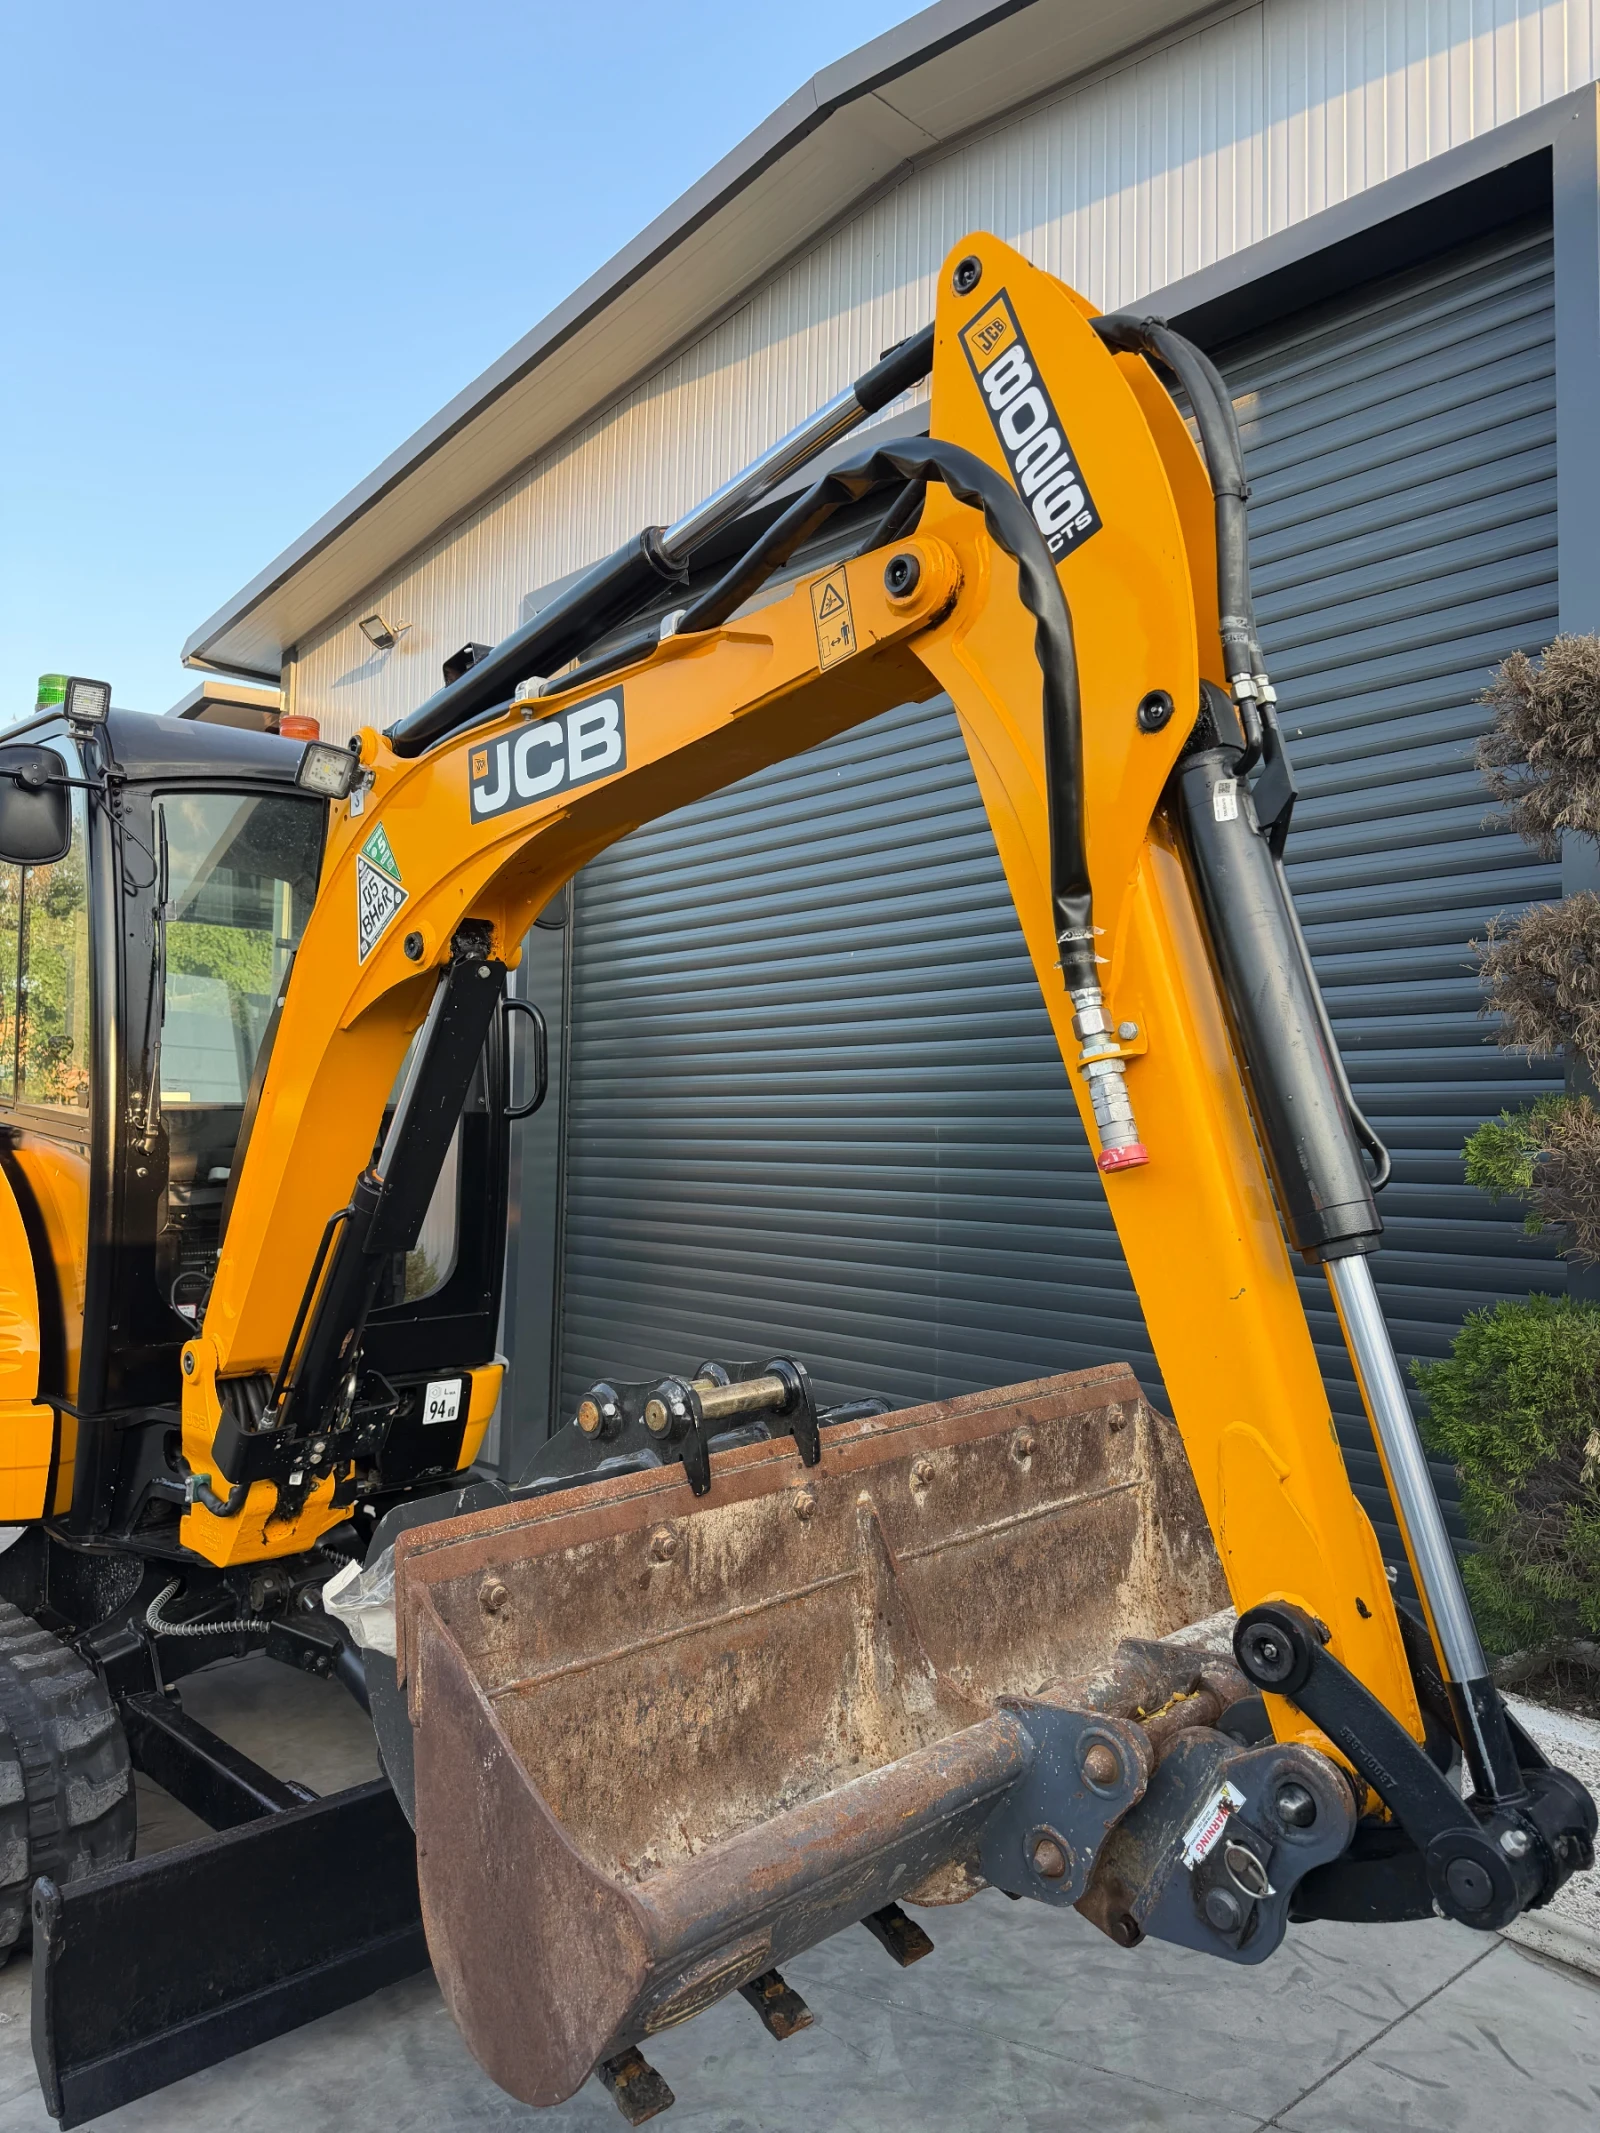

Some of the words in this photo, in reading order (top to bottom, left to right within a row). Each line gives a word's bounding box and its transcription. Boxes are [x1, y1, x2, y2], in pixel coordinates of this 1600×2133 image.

[978, 320, 1005, 351] JCB
[983, 345, 1084, 535] 8026
[1047, 510, 1092, 554] CTS
[473, 698, 622, 813] JCB
[377, 836, 386, 854] 5
[362, 886, 393, 936] BH6R
[430, 1400, 446, 1420] 94
[1195, 1808, 1230, 1855] WARNING
